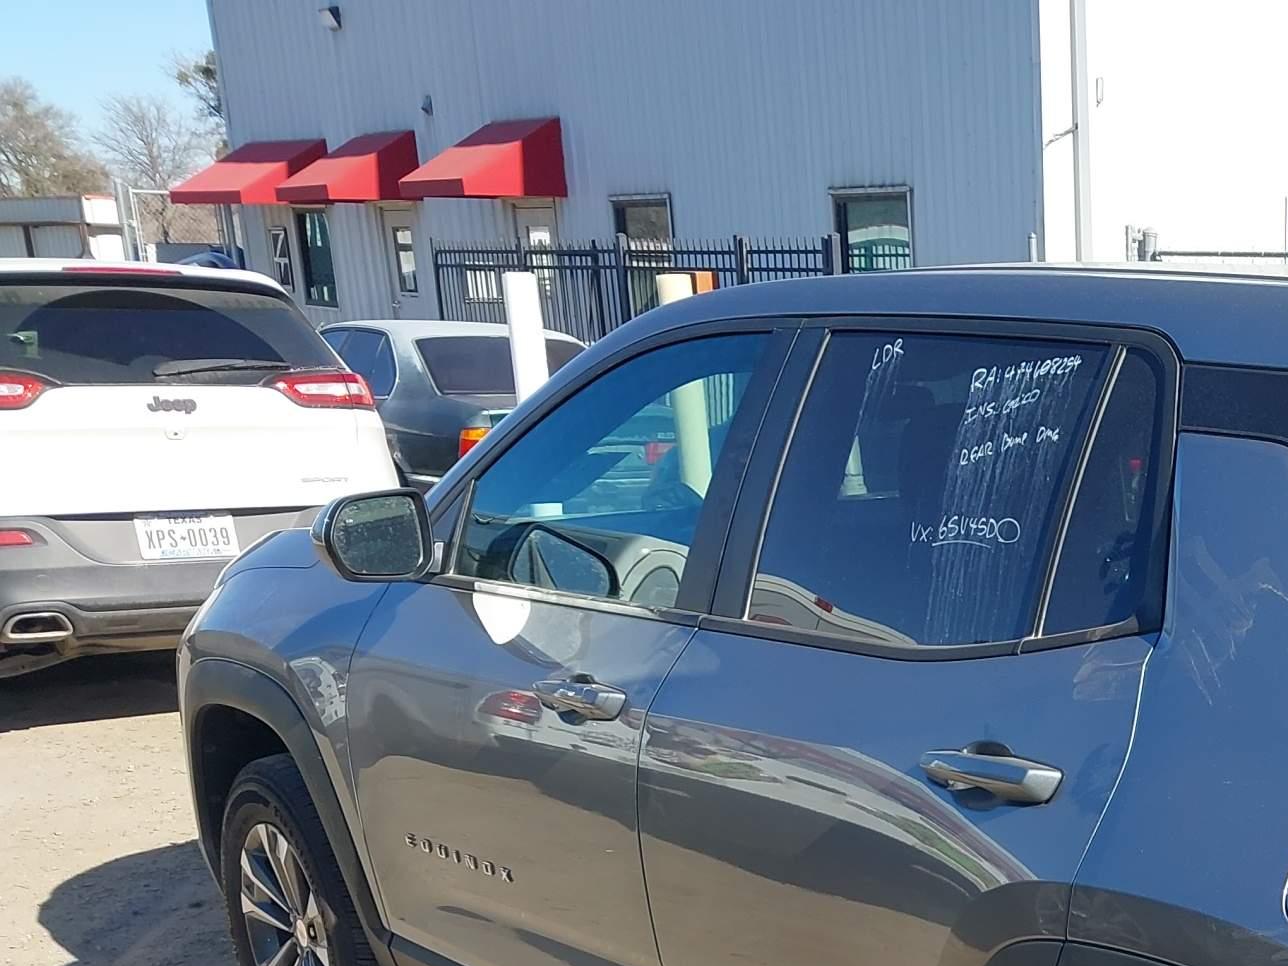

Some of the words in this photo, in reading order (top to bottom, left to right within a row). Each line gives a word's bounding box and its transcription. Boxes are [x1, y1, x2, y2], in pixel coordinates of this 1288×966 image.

[871, 337, 905, 370] LDR
[147, 396, 197, 414] Jeep
[403, 832, 515, 883] EQUINOX
